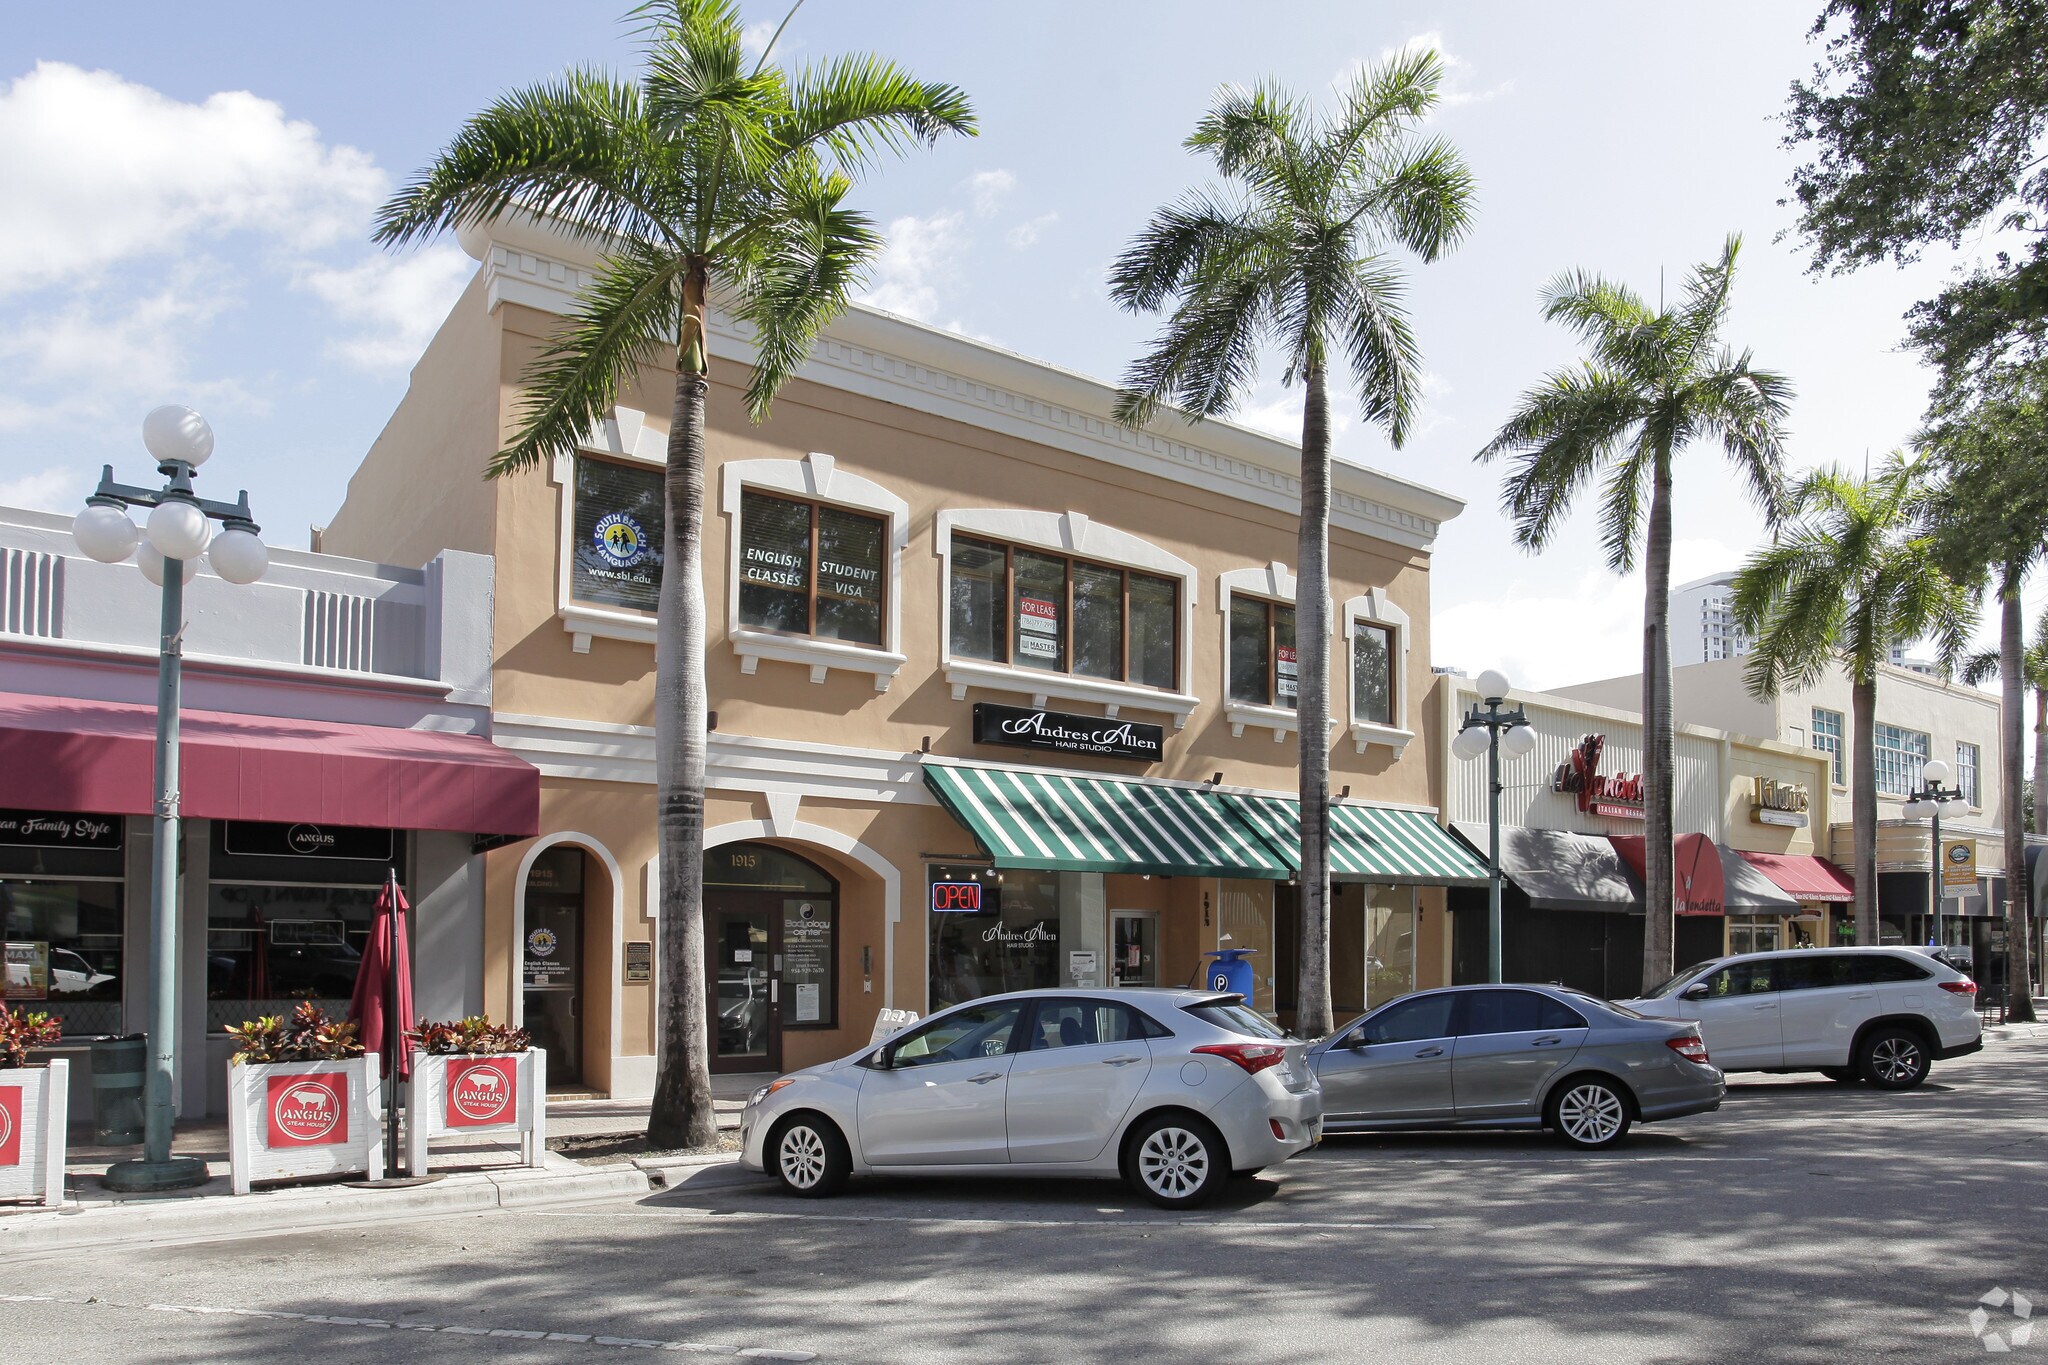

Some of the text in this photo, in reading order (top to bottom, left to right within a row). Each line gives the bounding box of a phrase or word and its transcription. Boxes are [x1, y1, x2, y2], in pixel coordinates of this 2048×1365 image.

[595, 514, 646, 547] SOUTH BEACH
[596, 544, 645, 568] LANGUAGES
[747, 548, 802, 568] ENGLISH
[588, 568, 651, 584] www.sbl.edu
[747, 568, 801, 587] CLASSES
[820, 561, 877, 581] STUDENT
[835, 582, 863, 598] VISA
[1021, 601, 1056, 617] FOR LEASE
[1030, 641, 1056, 652] MASTER
[1278, 650, 1289, 659] FOR
[1002, 713, 1157, 750] Andres Allen
[1055, 741, 1112, 753] HAIR STUDIO
[1598, 805, 1645, 818] ITALIAN RESTA
[0, 818, 111, 840] an Family Style
[296, 833, 335, 844] ANGUS
[731, 854, 756, 868] 1915
[934, 885, 979, 909] OPEN
[784, 920, 831, 930] Bodyology
[792, 928, 823, 937] center
[982, 921, 1057, 942] Andres Allen
[528, 928, 557, 944] SOUTH BEACH
[529, 945, 556, 957] LANGUAGES
[524, 960, 541, 968] English
[1218, 977, 1225, 990] P
[459, 1090, 503, 1103] ANGUS
[282, 1109, 332, 1122] ANGUS
